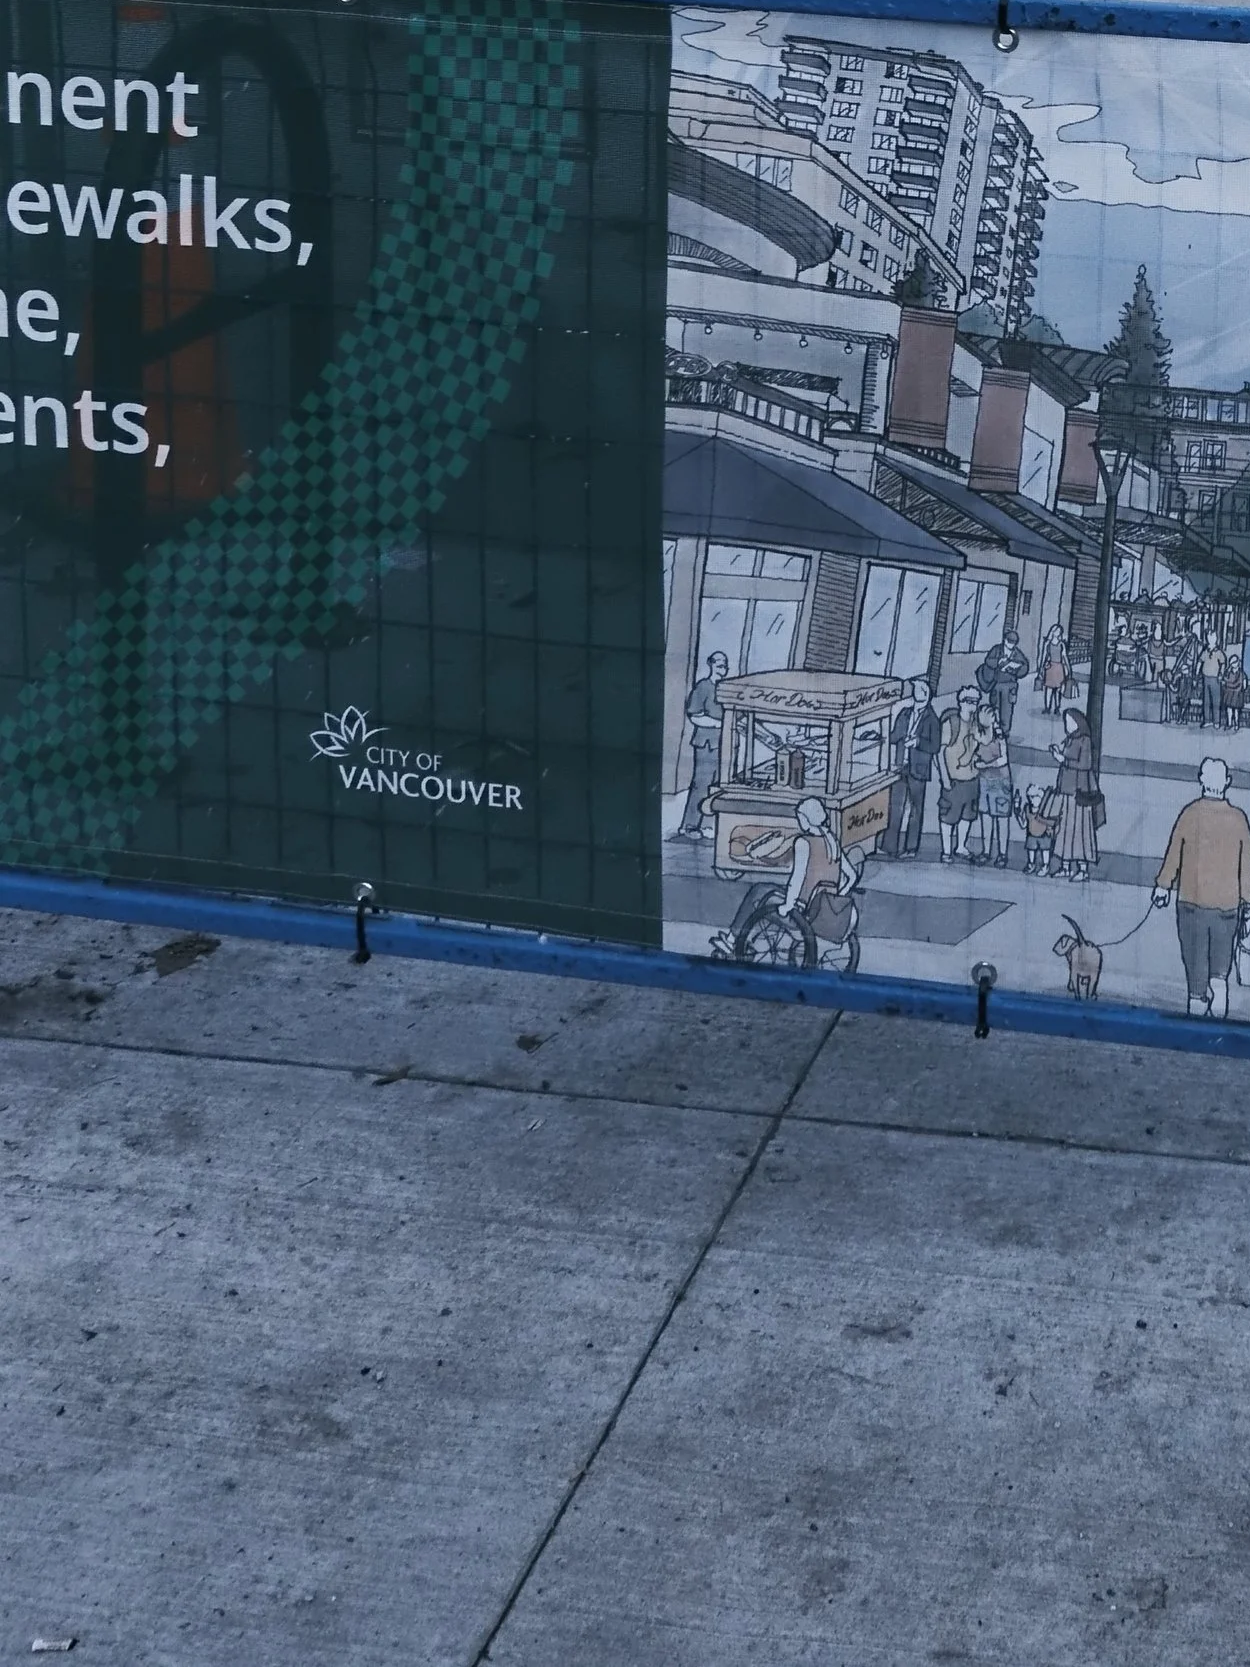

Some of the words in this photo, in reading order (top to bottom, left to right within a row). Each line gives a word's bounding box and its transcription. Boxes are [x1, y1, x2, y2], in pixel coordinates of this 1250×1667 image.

[6, 174, 314, 266] ewalks,
[0, 288, 80, 356] e,
[338, 764, 524, 810] VANCOUVER
[366, 746, 410, 767] CITY
[416, 752, 443, 772] OF
